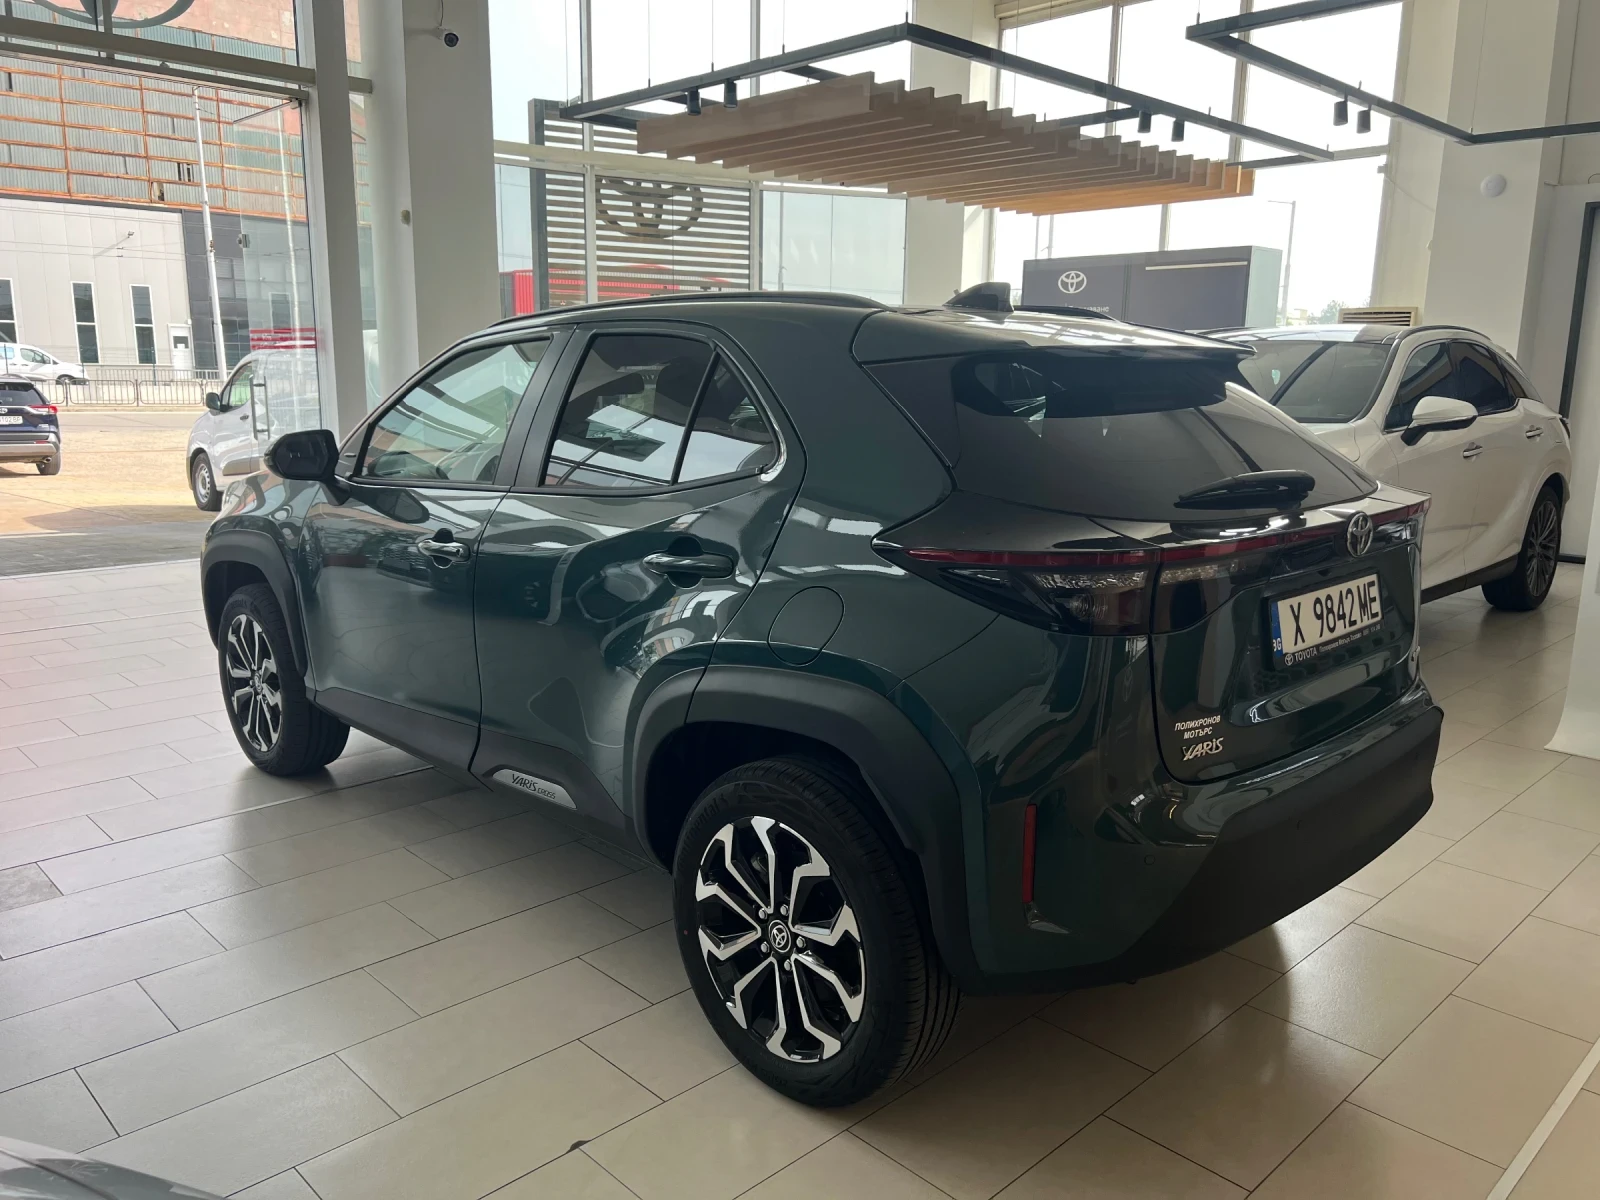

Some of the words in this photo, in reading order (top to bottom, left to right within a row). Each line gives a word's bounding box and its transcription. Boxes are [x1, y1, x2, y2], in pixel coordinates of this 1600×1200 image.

[1289, 602, 1306, 647] X
[1294, 646, 1318, 663] TOYOTA
[1174, 715, 1221, 731] ПОЛИХРОНОВ
[1183, 727, 1213, 740] МОТЪРС
[537, 787, 556, 800] CROSS
